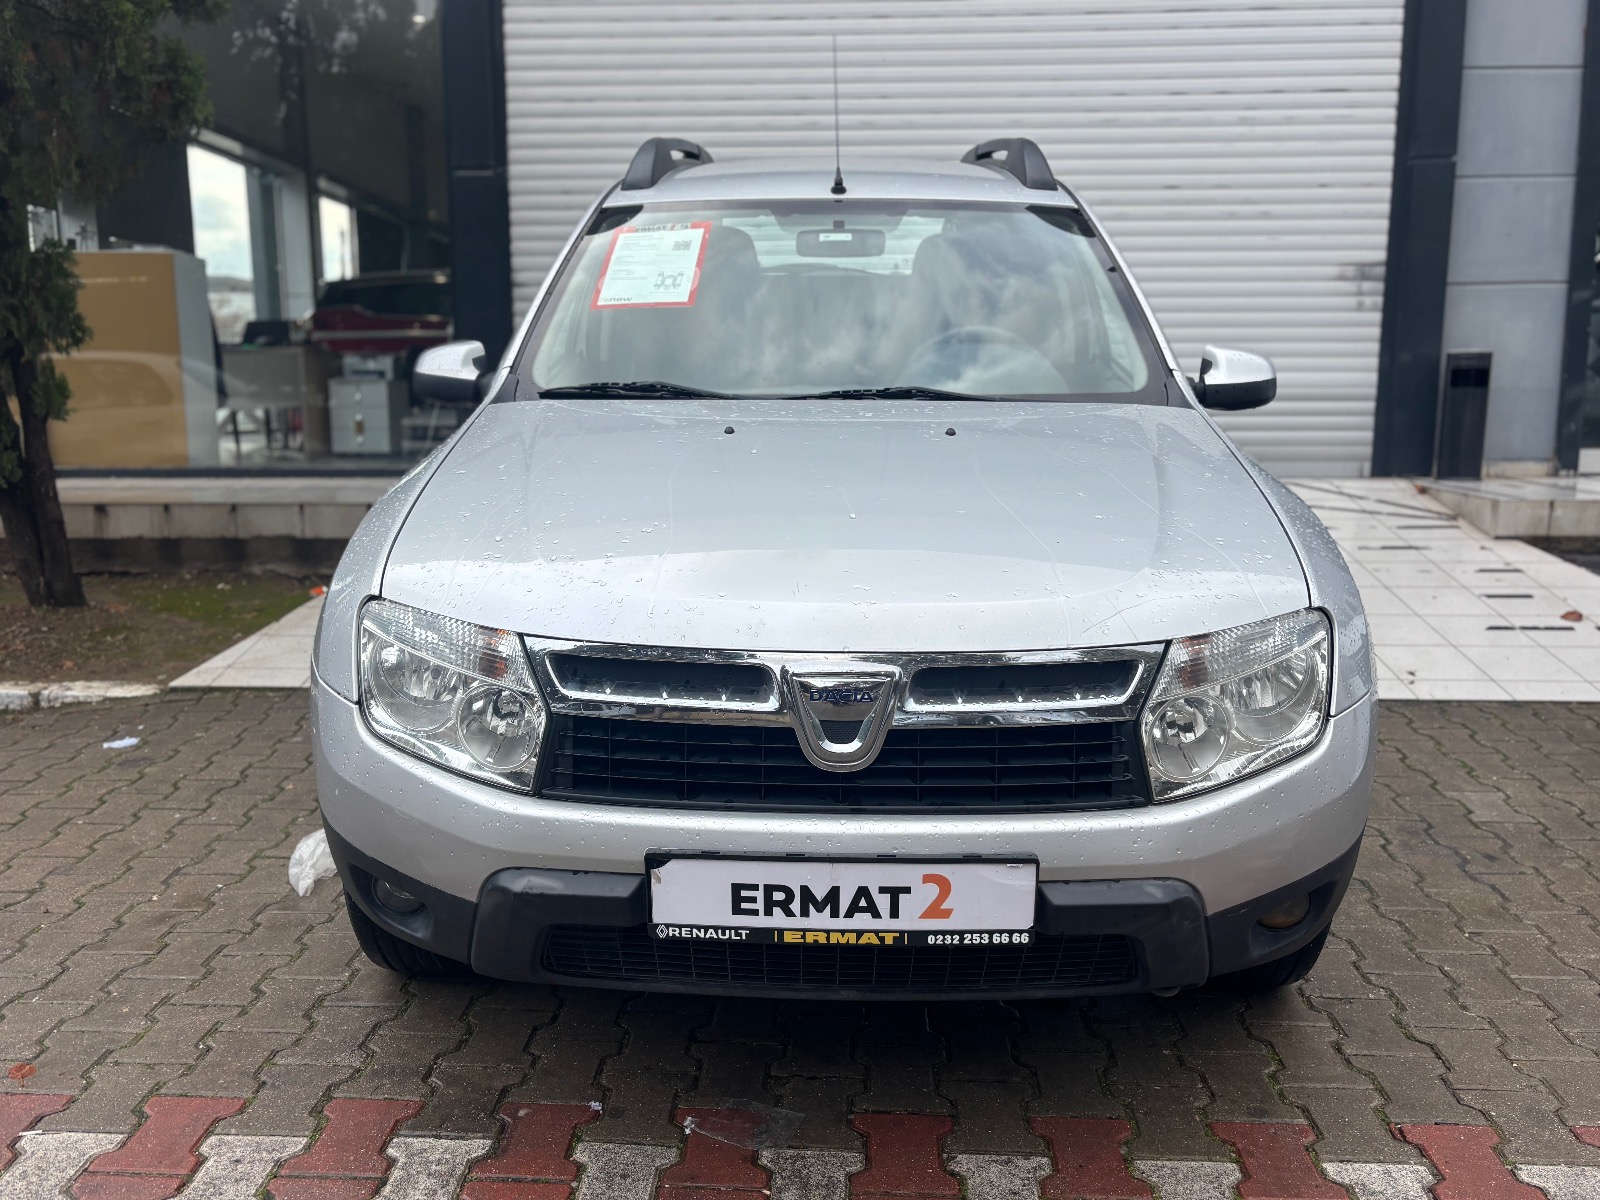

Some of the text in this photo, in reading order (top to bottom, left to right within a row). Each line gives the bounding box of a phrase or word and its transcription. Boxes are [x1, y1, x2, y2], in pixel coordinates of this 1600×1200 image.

[809, 689, 874, 703] DACIA
[731, 873, 955, 919] ERMAT 2
[668, 927, 1030, 945] RENAULT ERMAT 0232 253 66 66
